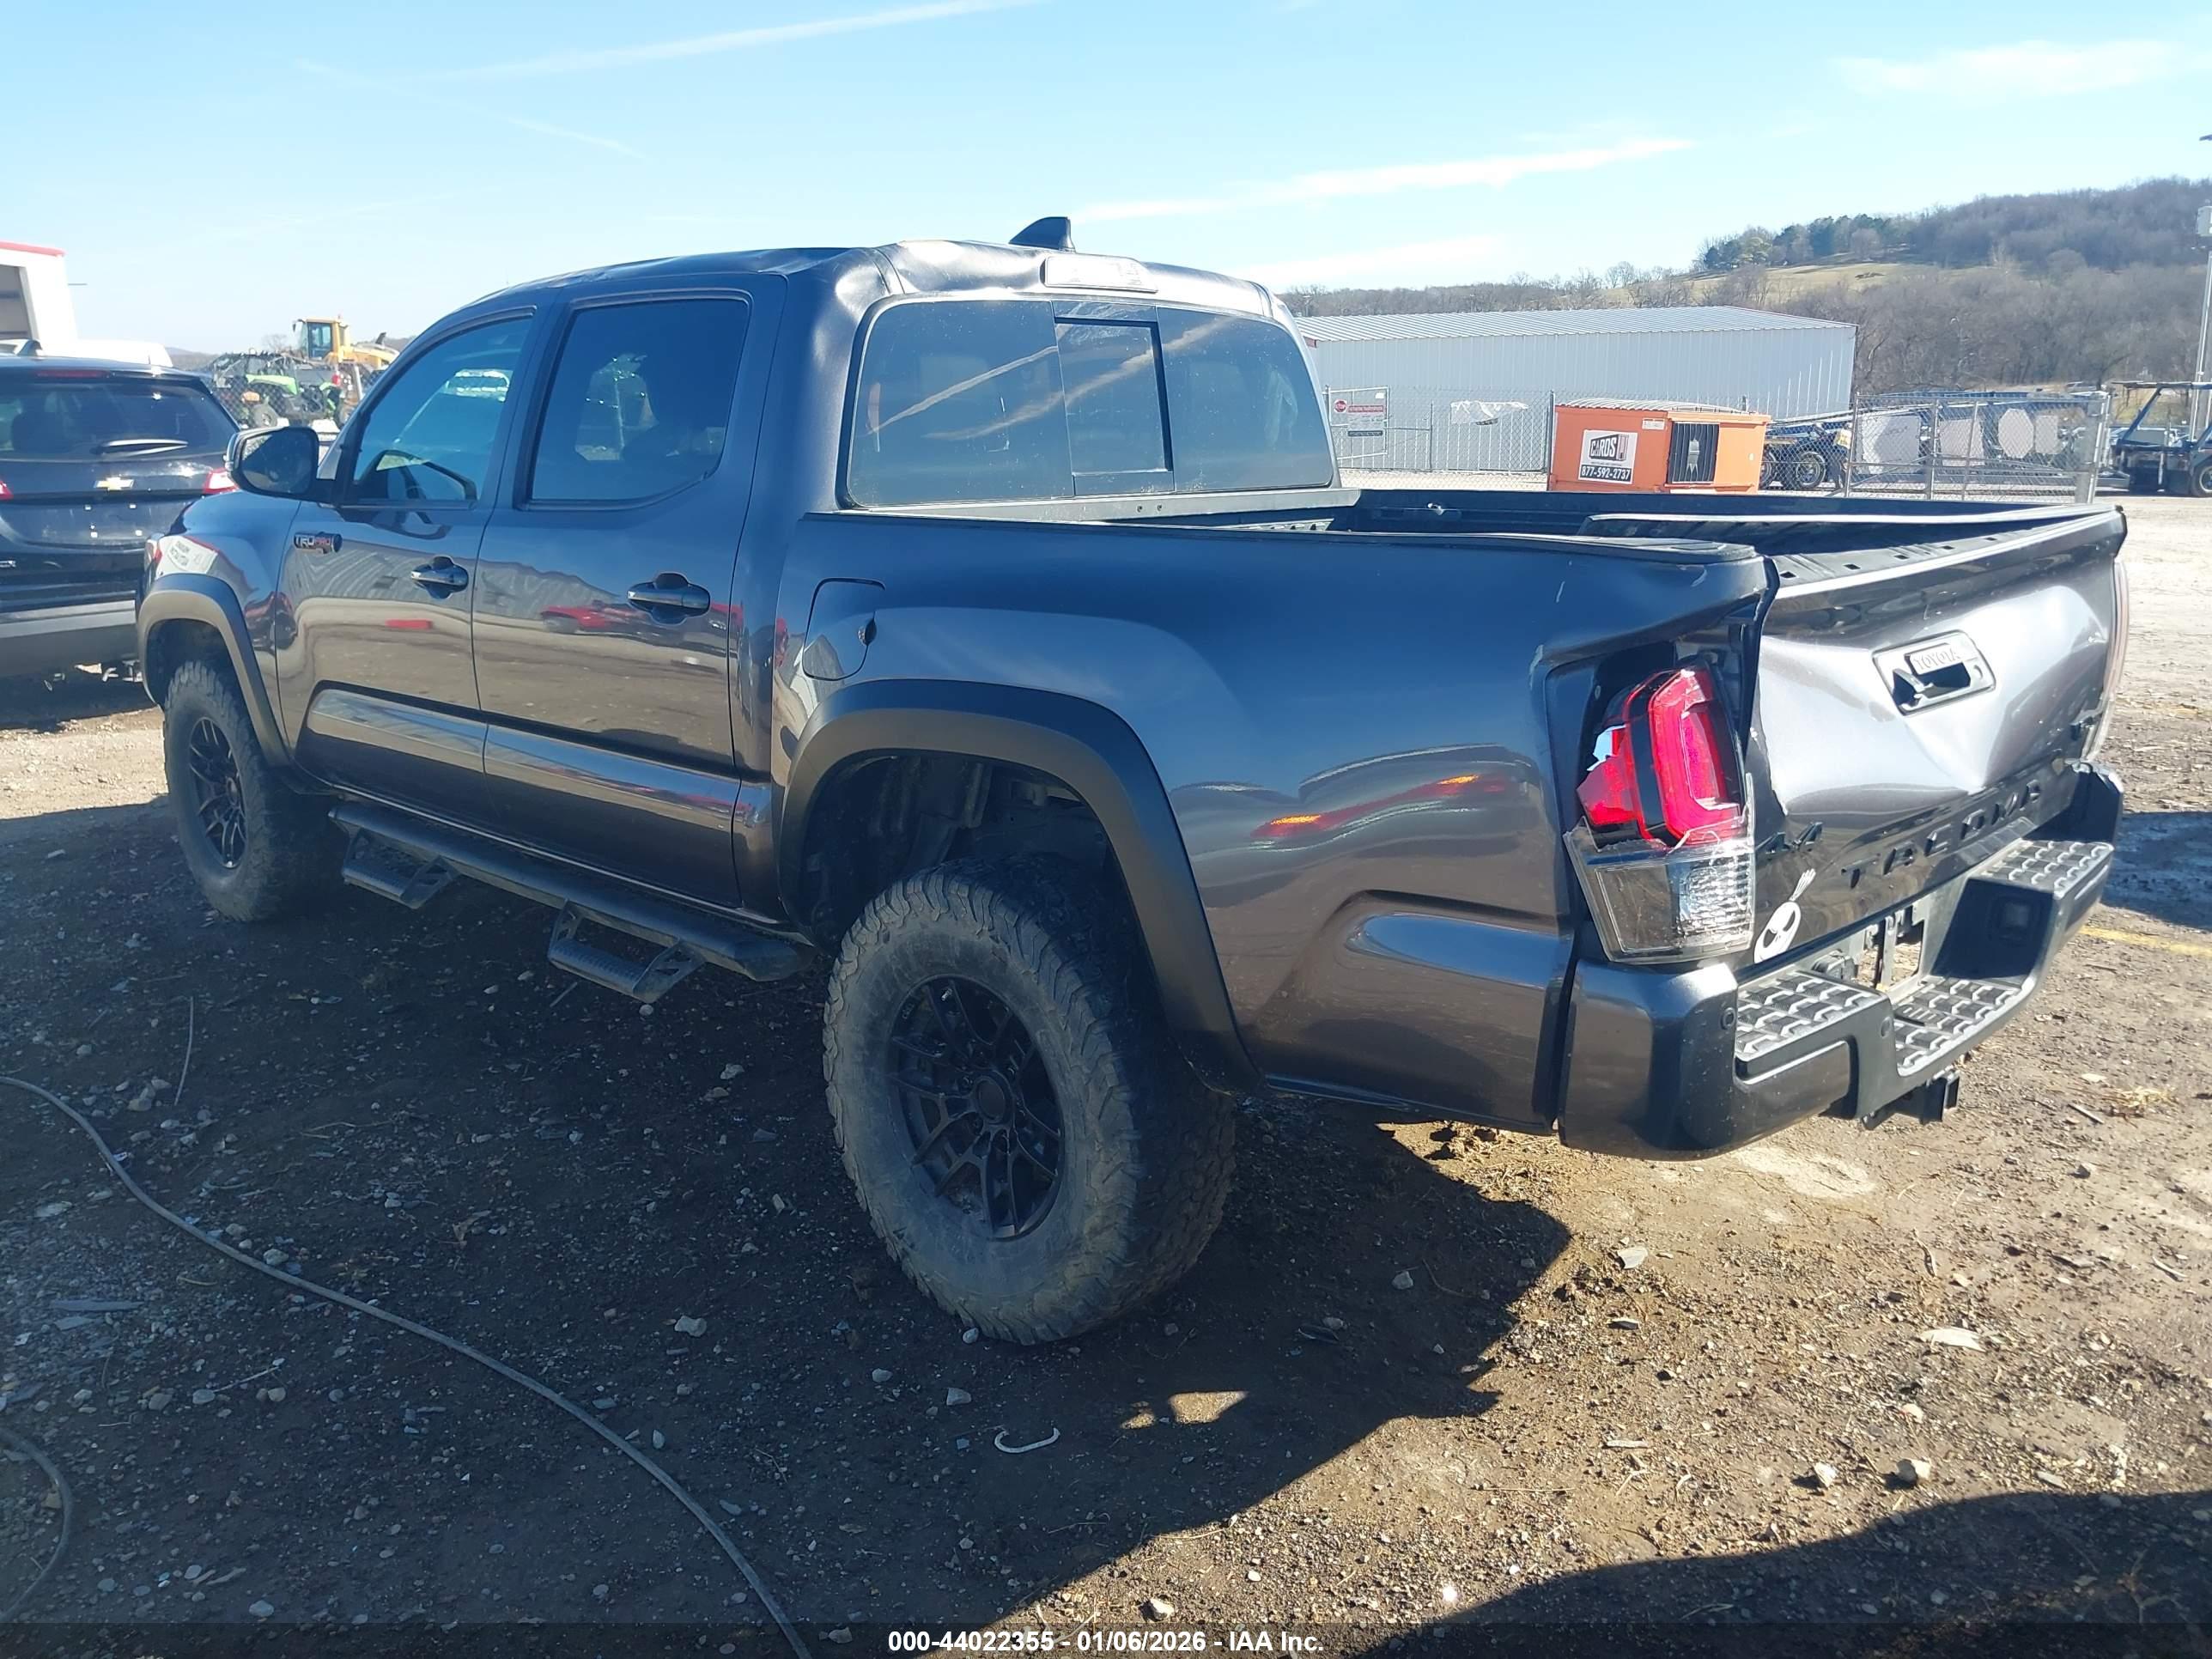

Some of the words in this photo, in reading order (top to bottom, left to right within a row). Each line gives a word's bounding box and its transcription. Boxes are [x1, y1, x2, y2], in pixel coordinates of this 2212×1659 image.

[1590, 437, 1617, 458] CARDS
[1582, 465, 1631, 480] 877-592-2737
[1914, 647, 1961, 670] TOYOTA
